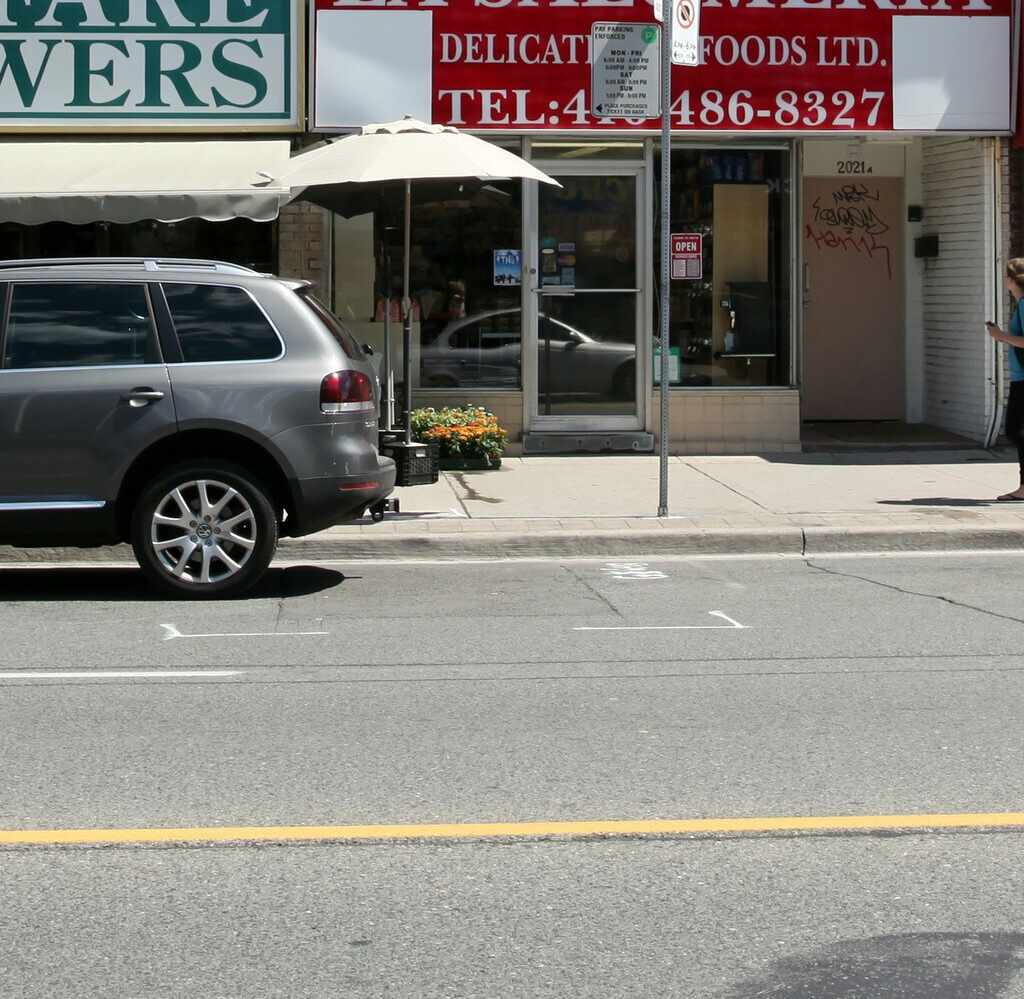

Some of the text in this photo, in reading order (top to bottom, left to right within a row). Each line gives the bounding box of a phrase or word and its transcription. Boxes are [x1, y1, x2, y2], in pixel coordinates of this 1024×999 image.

[698, 35, 807, 66] FOODS
[817, 36, 888, 67] LTD.
[675, 242, 697, 251] OPEN
